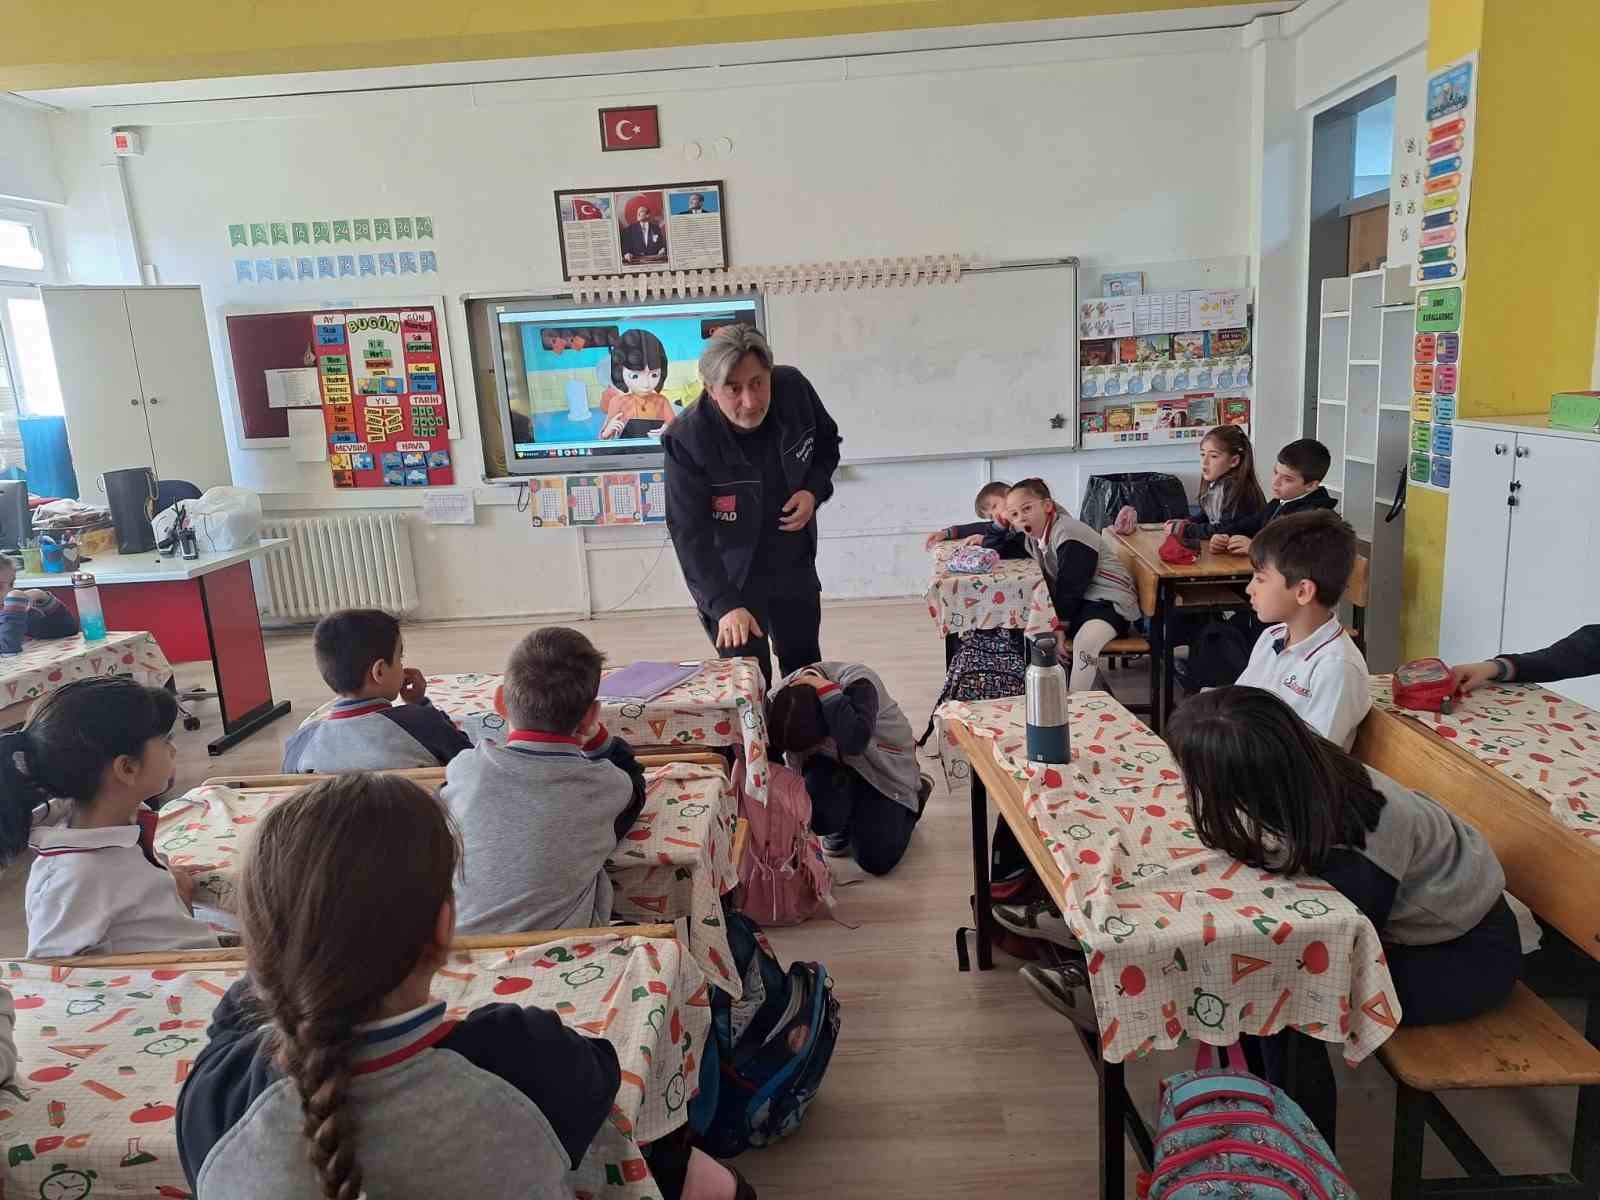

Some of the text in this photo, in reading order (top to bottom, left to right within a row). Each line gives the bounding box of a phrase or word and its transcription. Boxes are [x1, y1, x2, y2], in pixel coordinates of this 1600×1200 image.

[355, 223, 369, 236] 28
[375, 222, 391, 234] 32
[397, 222, 410, 233] 36
[323, 315, 334, 324] AY
[348, 315, 400, 334] BUGÜN
[531, 943, 597, 970] 123
[7, 1131, 93, 1169] ABC
